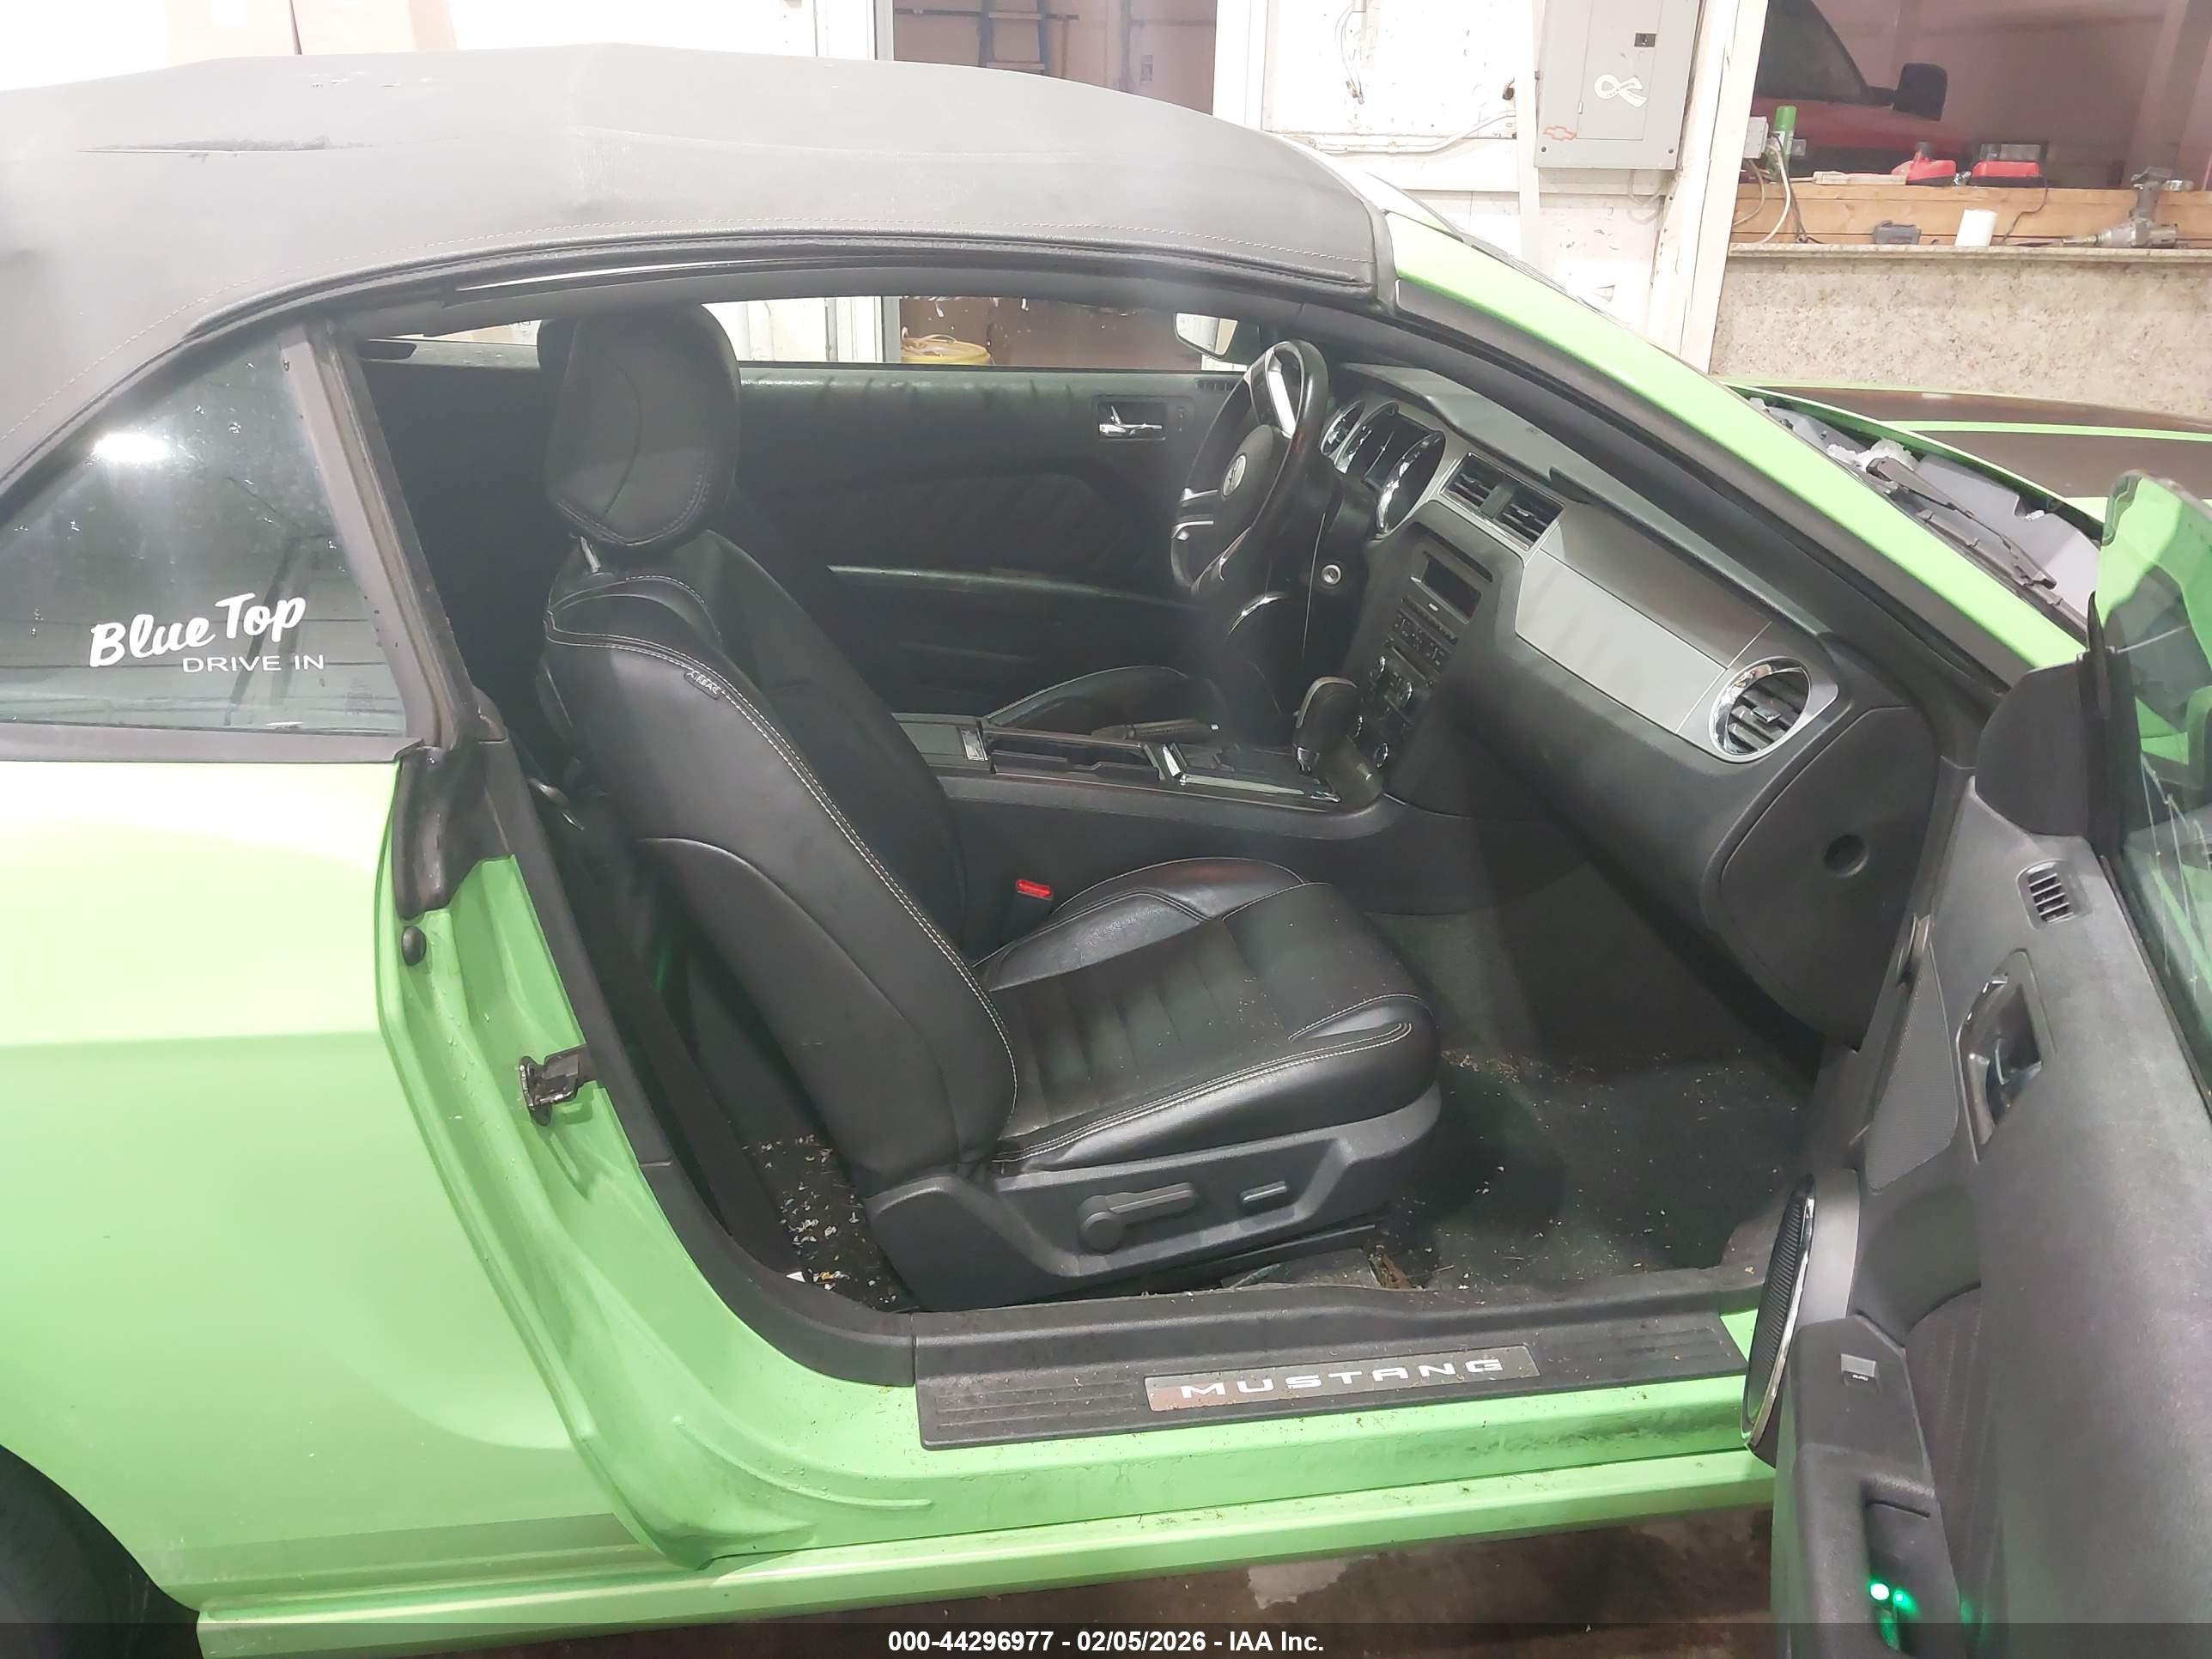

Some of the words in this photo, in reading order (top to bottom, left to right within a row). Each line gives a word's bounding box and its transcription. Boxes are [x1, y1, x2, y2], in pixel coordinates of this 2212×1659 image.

[89, 613, 216, 667] Blue
[215, 592, 307, 642] Top
[182, 655, 282, 673] DRIVE
[295, 654, 324, 670] IN
[1181, 1358, 1504, 1399] MUSTANG
